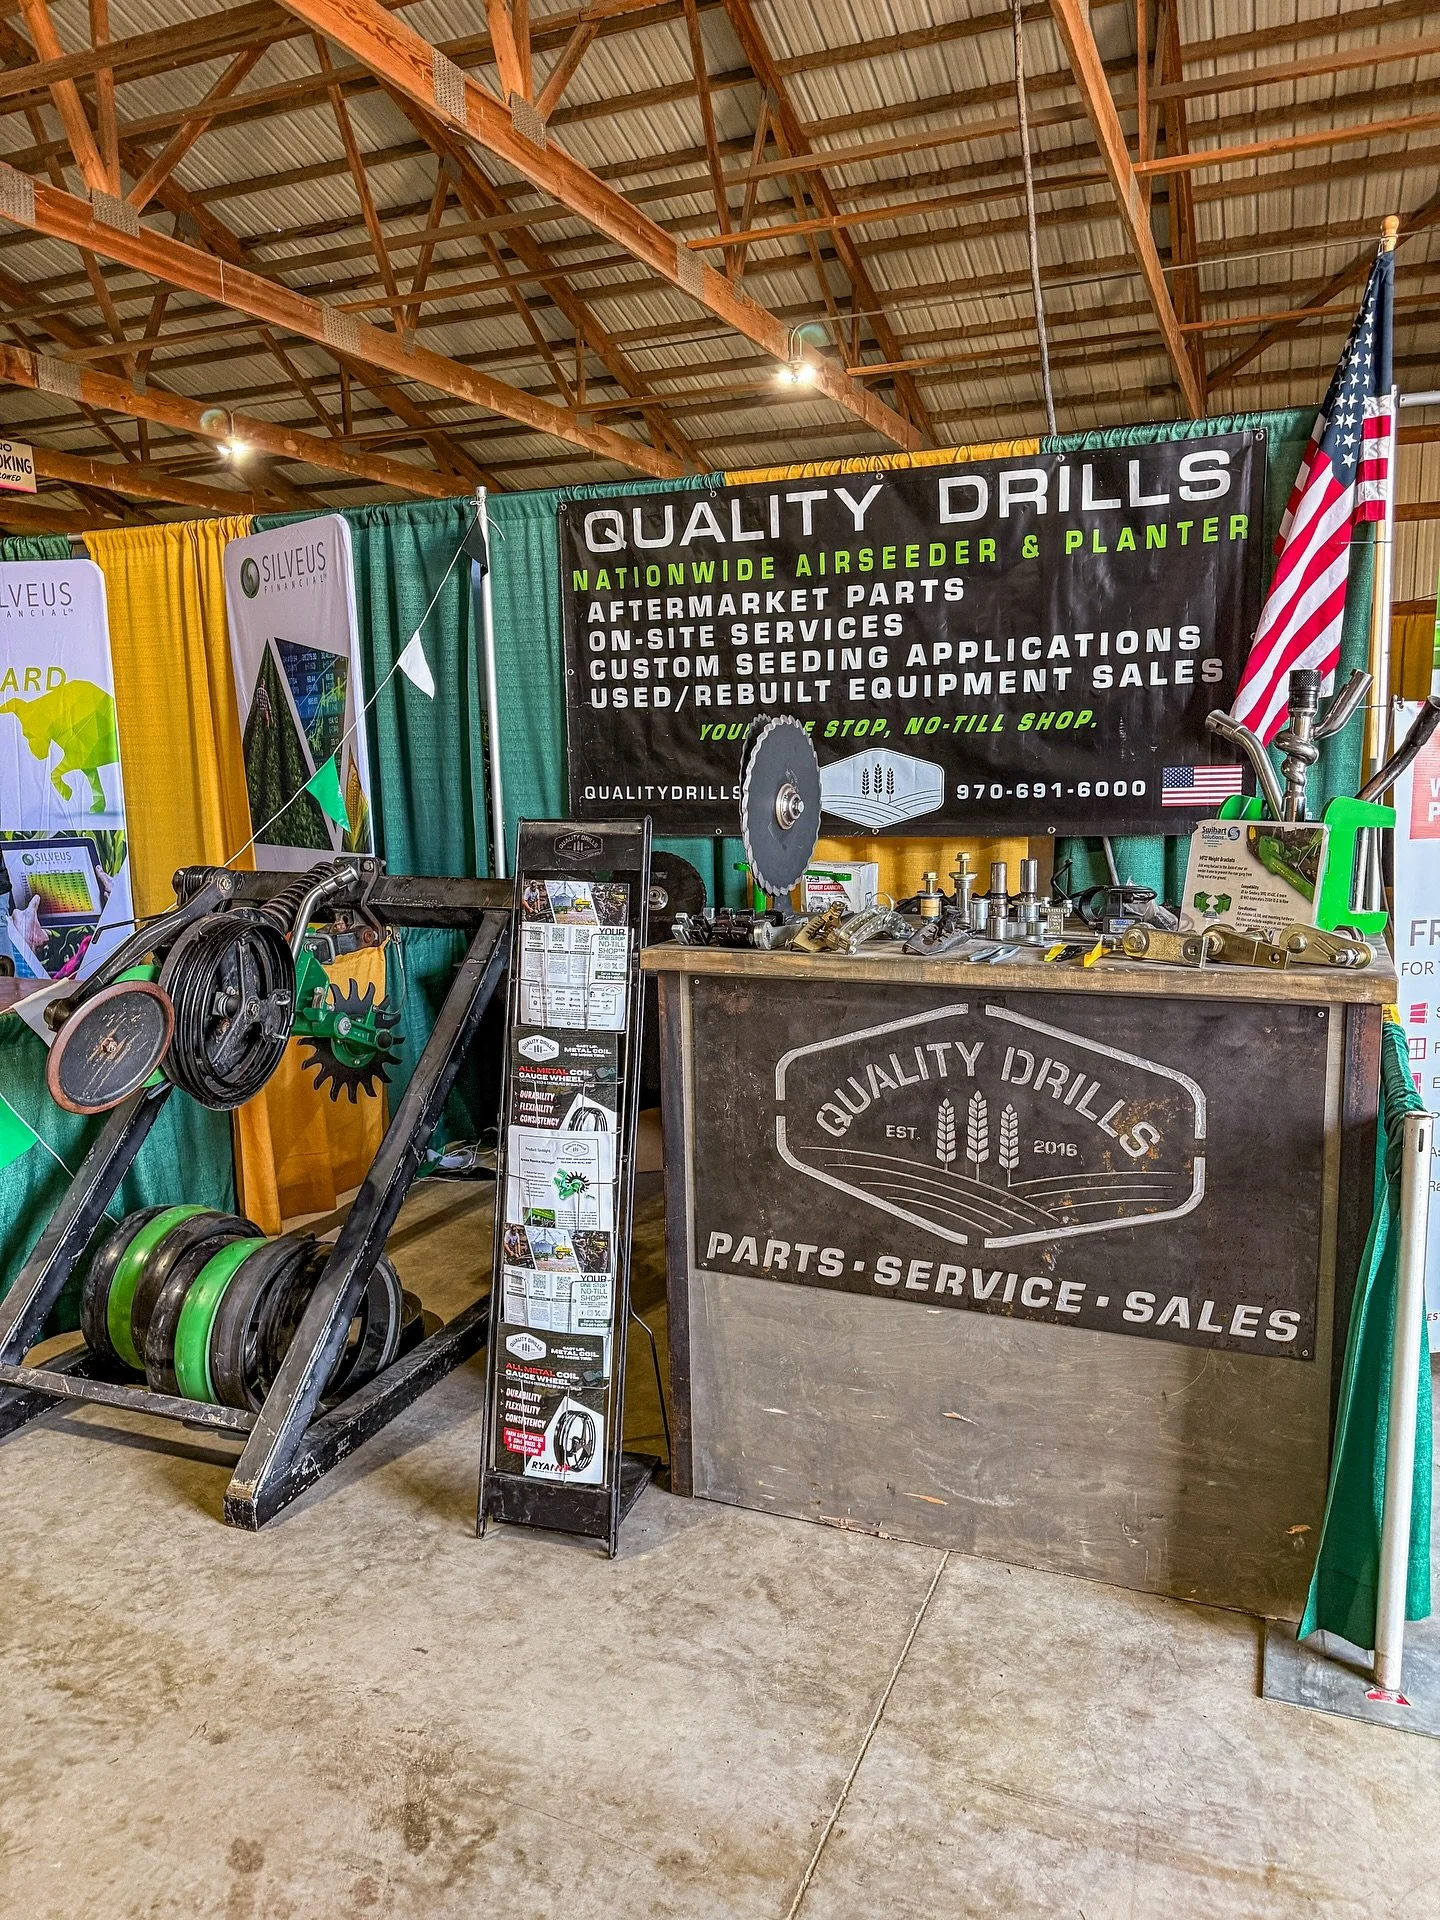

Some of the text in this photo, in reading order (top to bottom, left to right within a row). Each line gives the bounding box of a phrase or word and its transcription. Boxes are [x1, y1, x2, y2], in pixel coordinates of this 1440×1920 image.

[584, 449, 1231, 553] QUALITY DRILLS
[572, 513, 1249, 591] NATIONWIDE AIRSEEDER & PLANTER
[262, 542, 326, 582] SILVEUS
[587, 578, 964, 624] AFTERMARKET PARTS
[589, 613, 903, 652] ON-SITE SERVICES
[589, 625, 1201, 680] CUSTOM SEEDING APPLICATIONS
[591, 657, 1223, 712] USED/REBUILT EQUIPMENT SALES
[823, 717, 892, 738] STOP,
[903, 713, 1004, 736] NO-TILL
[1017, 709, 1098, 732] SHOP.
[957, 780, 1146, 799] 970-691-6000
[35, 851, 72, 862] SILVEUS
[599, 927, 625, 935] YOUR
[1402, 961, 1434, 976] FOR
[564, 1046, 592, 1054] METAL
[536, 1067, 568, 1075] METAL
[549, 1074, 584, 1082] WHEEL
[816, 1042, 1161, 1158] QUALITY DRILLS
[885, 1124, 922, 1141] EST.
[1033, 1139, 1079, 1158] 2016
[581, 1274, 607, 1282] YOUR
[706, 1231, 1302, 1342] PARTS SERVICE SALES
[551, 1348, 578, 1356] METAL
[505, 1369, 536, 1381] GAUGE
[537, 1375, 571, 1386] WHEEL
[506, 1362, 580, 1380] ALL METAL COIL
